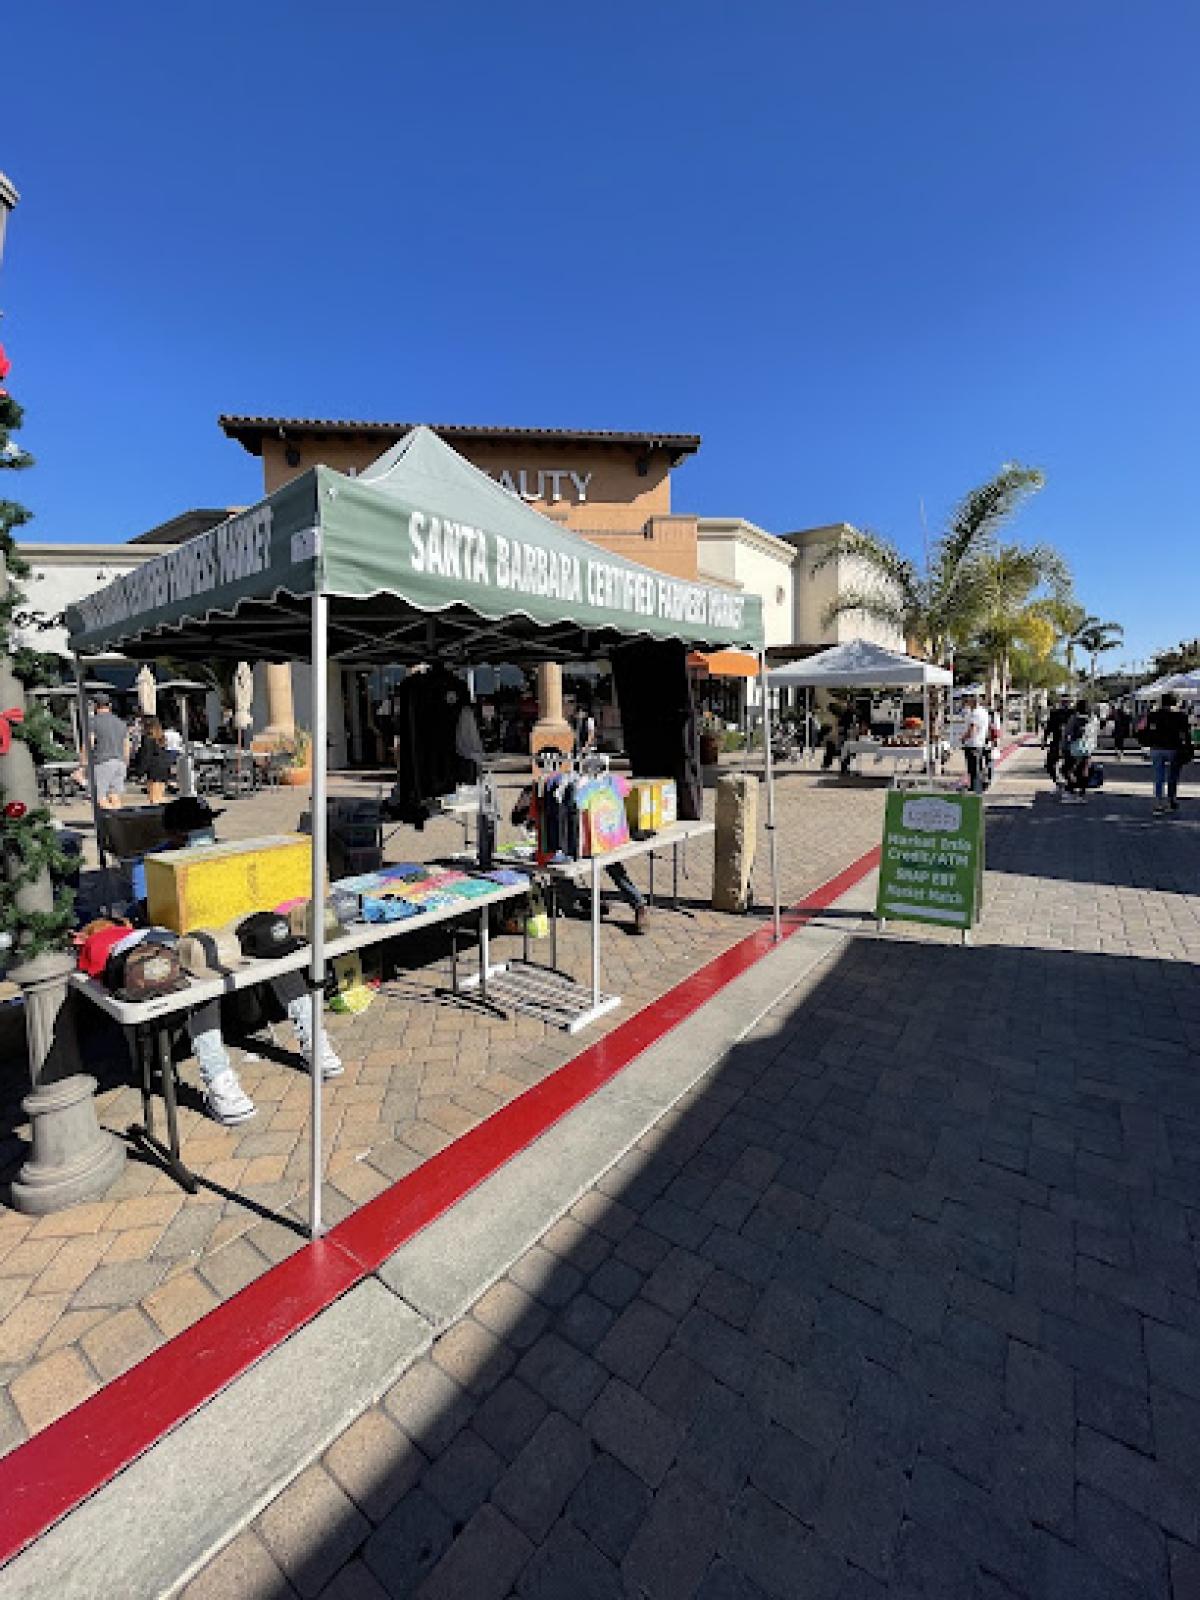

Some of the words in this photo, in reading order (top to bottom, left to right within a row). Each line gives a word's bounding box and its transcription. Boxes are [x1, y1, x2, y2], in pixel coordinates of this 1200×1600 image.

[494, 470, 592, 500] AUTY
[409, 511, 489, 585] SANTA
[496, 534, 583, 603] BARBARA
